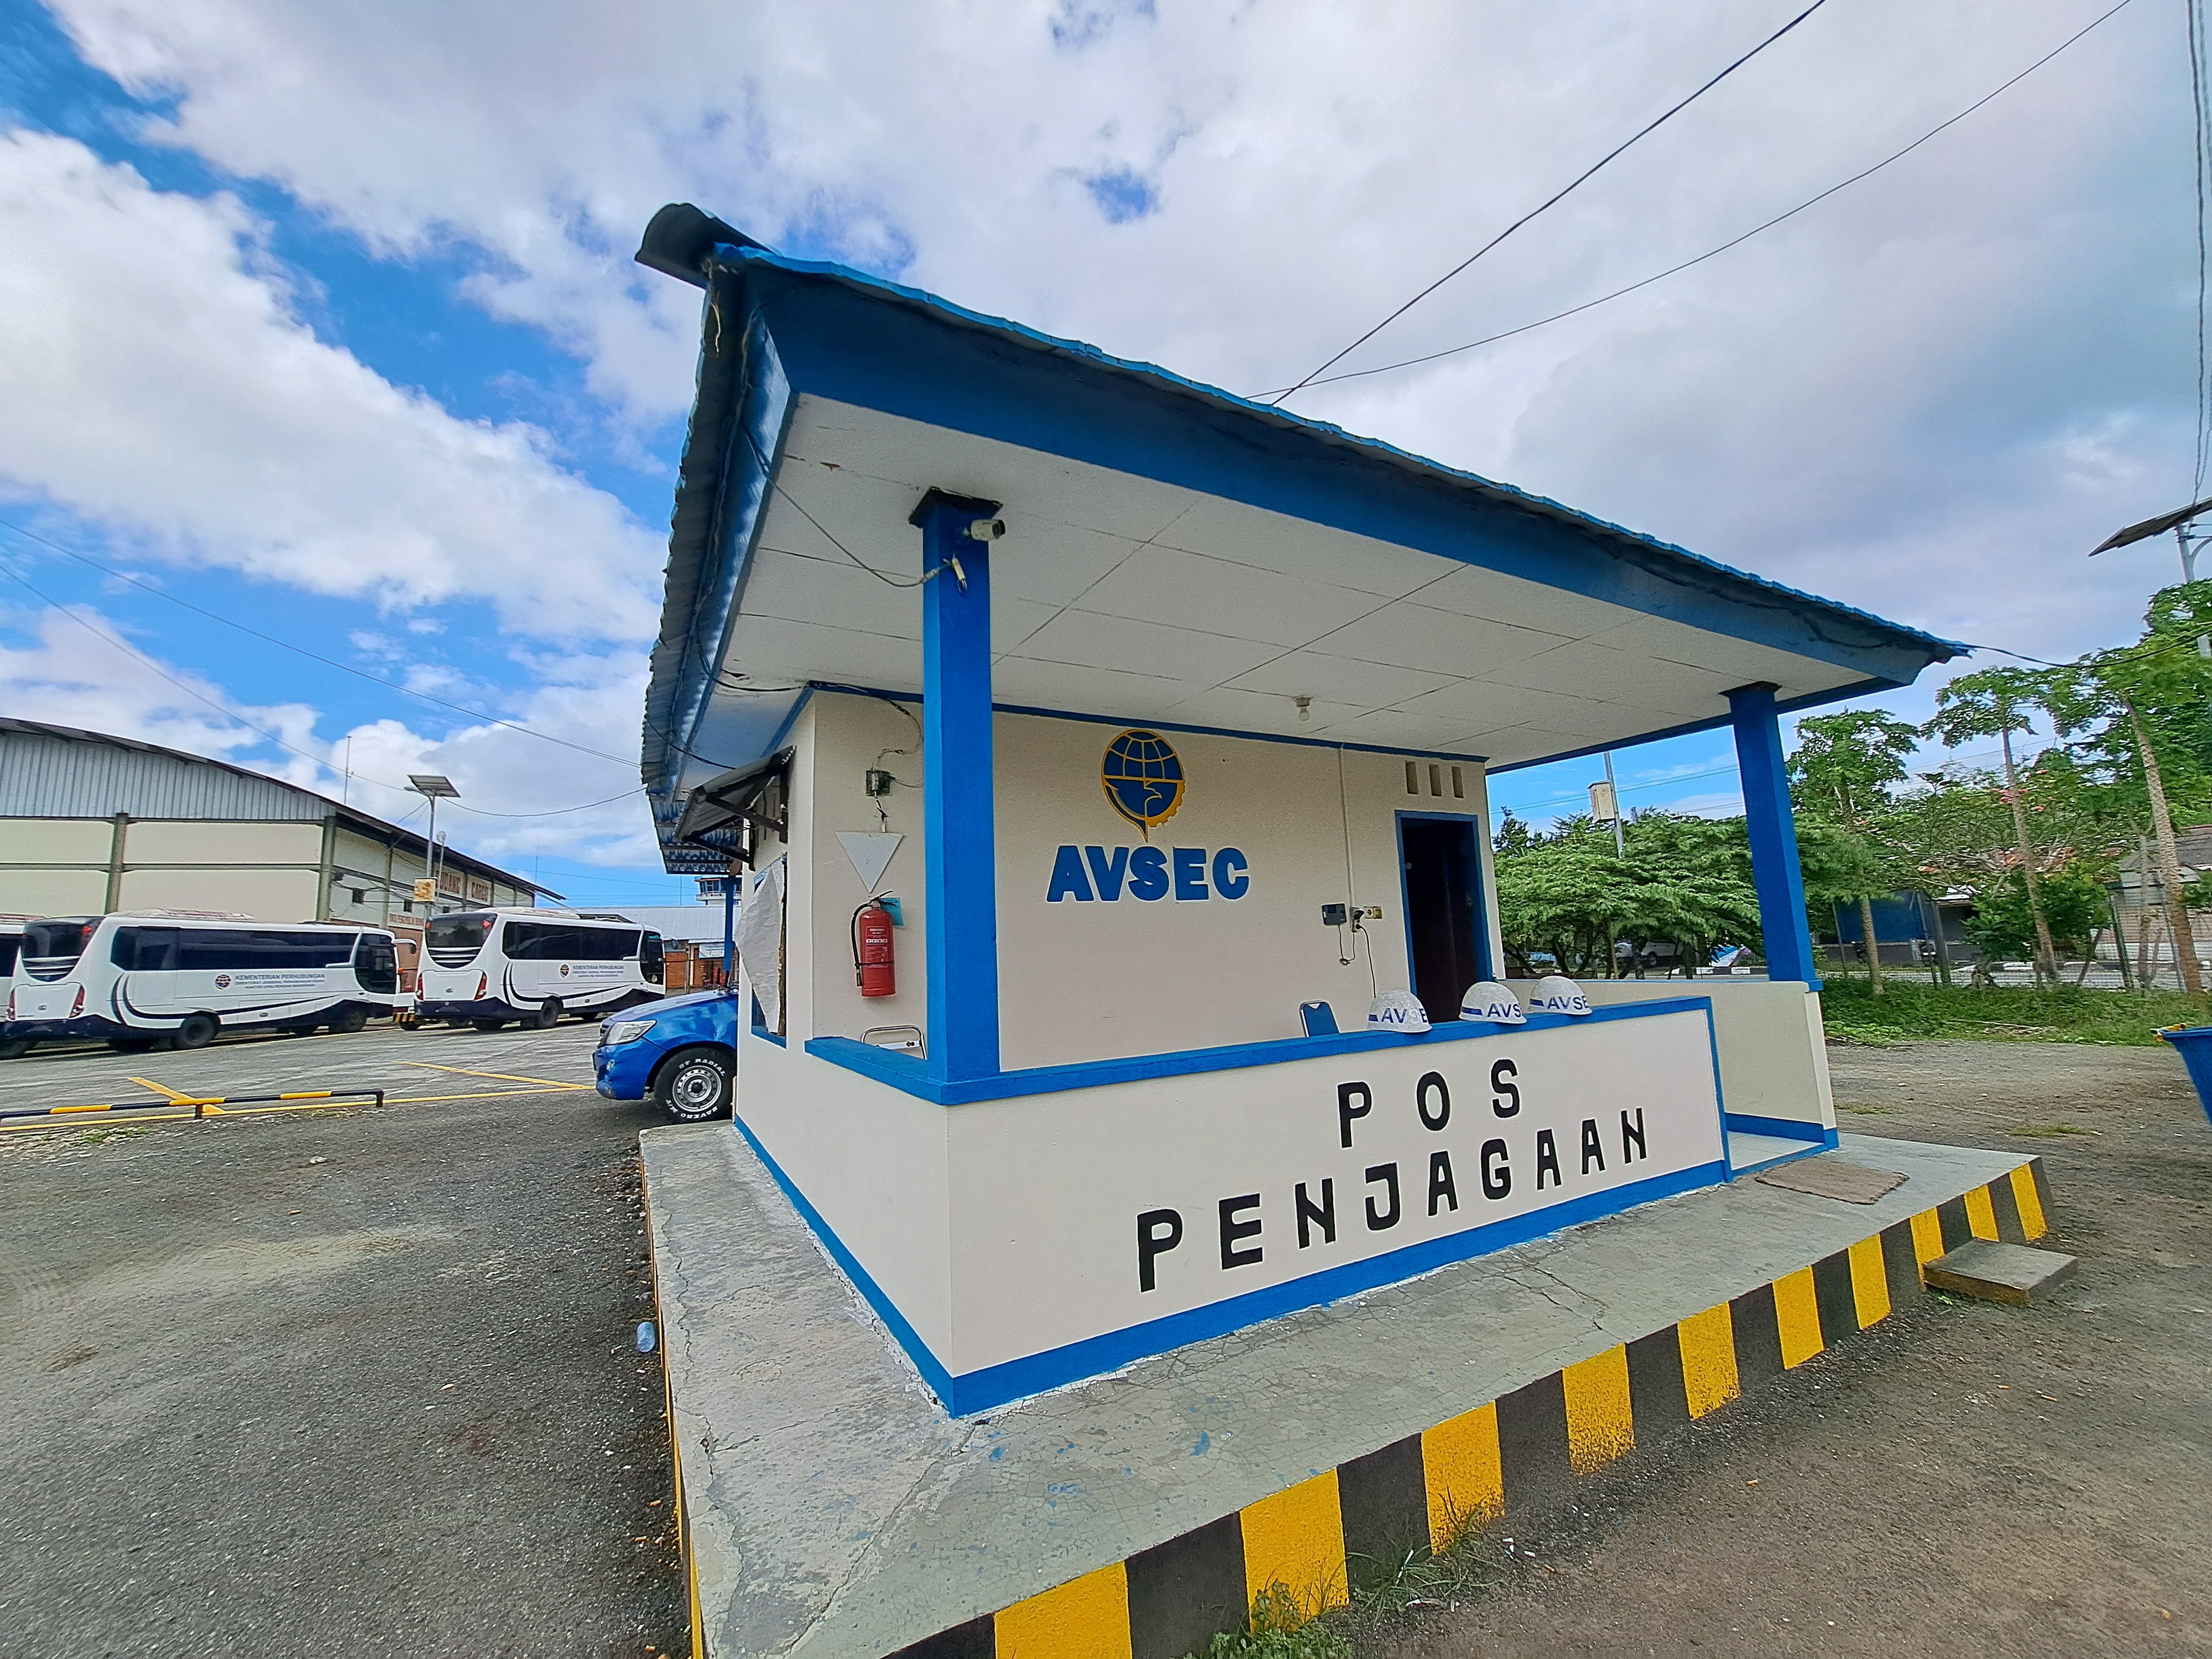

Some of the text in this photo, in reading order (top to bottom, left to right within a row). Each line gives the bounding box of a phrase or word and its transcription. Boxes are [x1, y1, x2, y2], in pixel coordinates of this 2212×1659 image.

[1046, 845, 1250, 902] AVSEC
[679, 1058, 726, 1076] GT RADIAL
[680, 1105, 718, 1119] SAVERO
[1337, 1058, 1520, 1148] POS
[1136, 1108, 1648, 1293] PENJAGAAN
